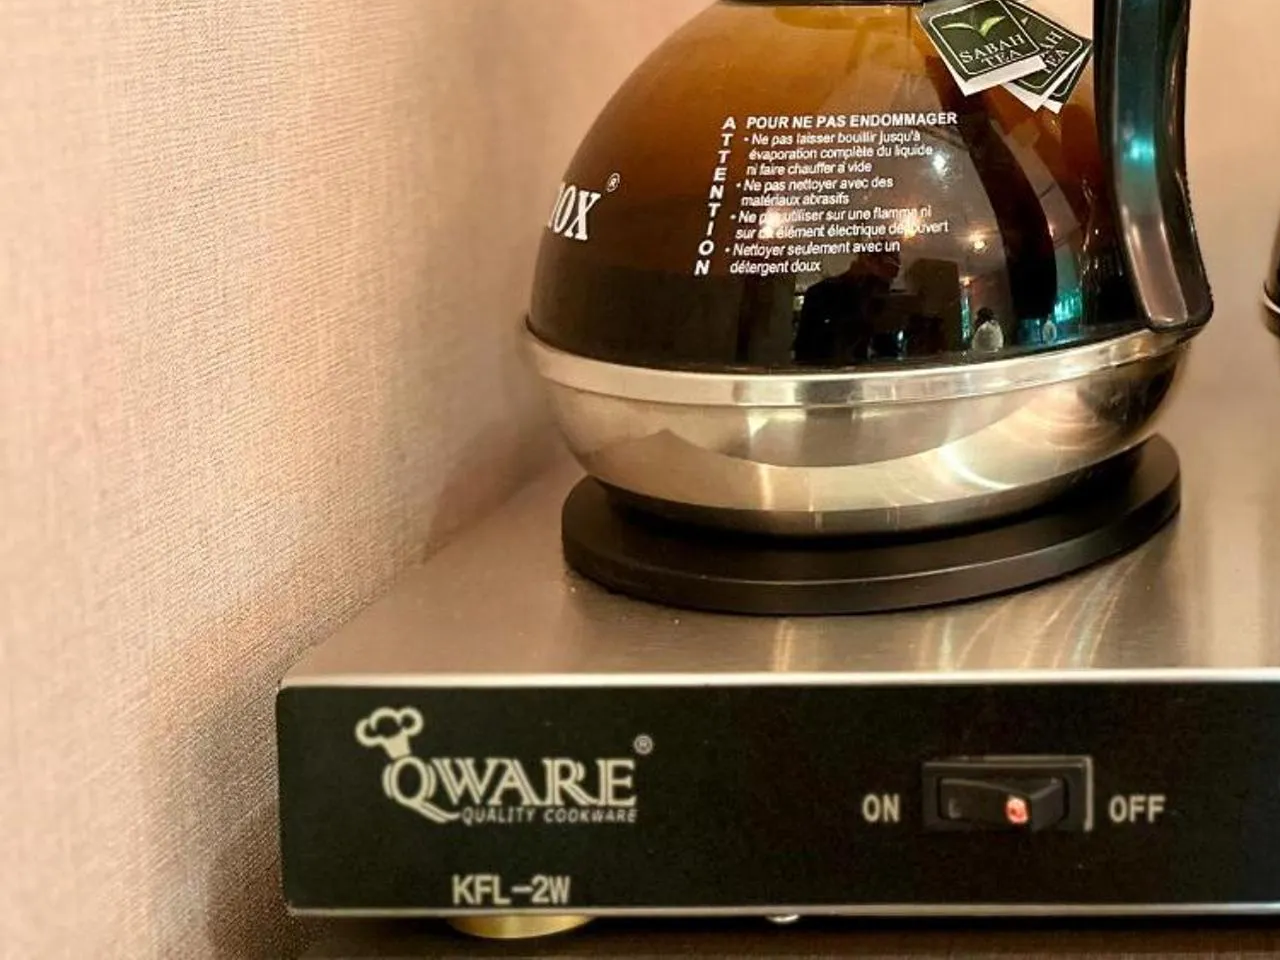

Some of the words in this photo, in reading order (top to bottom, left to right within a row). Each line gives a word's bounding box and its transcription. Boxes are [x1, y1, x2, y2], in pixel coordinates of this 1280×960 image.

[959, 34, 1025, 64] SABAH
[981, 50, 1023, 69] TEA
[746, 116, 789, 130] POUR
[792, 116, 813, 128] NE
[816, 115, 846, 128] PAS
[849, 112, 957, 127] ENDOMMAGER
[751, 133, 769, 145] Ne
[771, 135, 793, 147] pas
[749, 147, 817, 162] évaporation
[820, 145, 874, 160] complète
[876, 144, 892, 157] du
[895, 143, 933, 158] liquide
[746, 163, 758, 175] ni
[760, 162, 785, 175] faire
[788, 161, 836, 174] chauffer
[847, 160, 872, 173] vide
[743, 179, 762, 191] Ne
[763, 181, 786, 193] pas
[788, 178, 838, 192] nettoyer
[840, 178, 869, 189] avec
[871, 176, 894, 188] des
[741, 194, 800, 206] matériaux
[802, 192, 850, 205] abrasifs
[738, 210, 757, 223] Ne
[826, 209, 847, 221] sur
[848, 208, 871, 220] une
[920, 204, 932, 217] ni
[735, 228, 756, 239] sur
[827, 223, 886, 238] électrique
[889, 220, 949, 235] déouvert
[733, 243, 785, 259] Nettoyer
[787, 241, 850, 256] seulement
[853, 241, 882, 253] avec
[885, 240, 900, 252] un
[730, 260, 789, 276] détergent
[790, 259, 821, 273] doux
[382, 756, 638, 824] QWARE
[462, 808, 535, 825] QUALITY
[543, 808, 640, 824] COOKWARE
[862, 794, 900, 823] ON
[1108, 795, 1165, 823] OFF
[452, 875, 571, 905] KFL-2W
